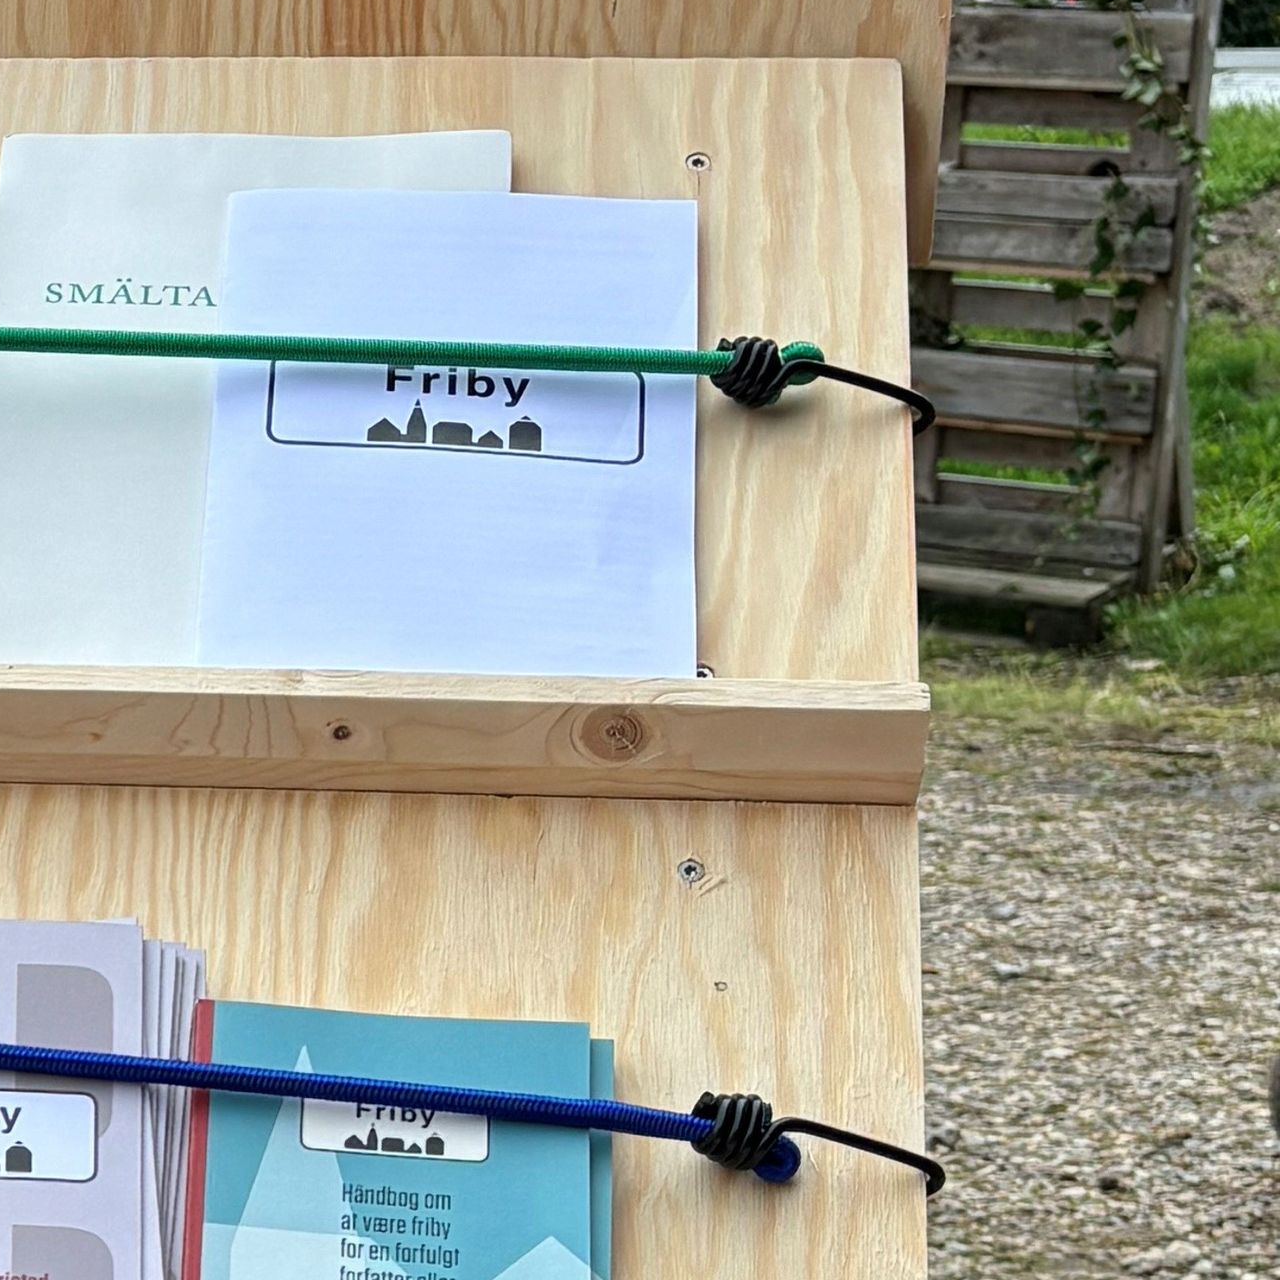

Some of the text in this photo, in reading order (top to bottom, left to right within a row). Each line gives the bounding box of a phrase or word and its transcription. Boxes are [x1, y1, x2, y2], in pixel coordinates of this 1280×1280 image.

[44, 276, 217, 308] SMÄLTA
[385, 364, 531, 407] Friby
[424, 1193, 452, 1211] om
[341, 1213, 451, 1241] at være friby
[340, 1238, 460, 1269] for en forfulgt
